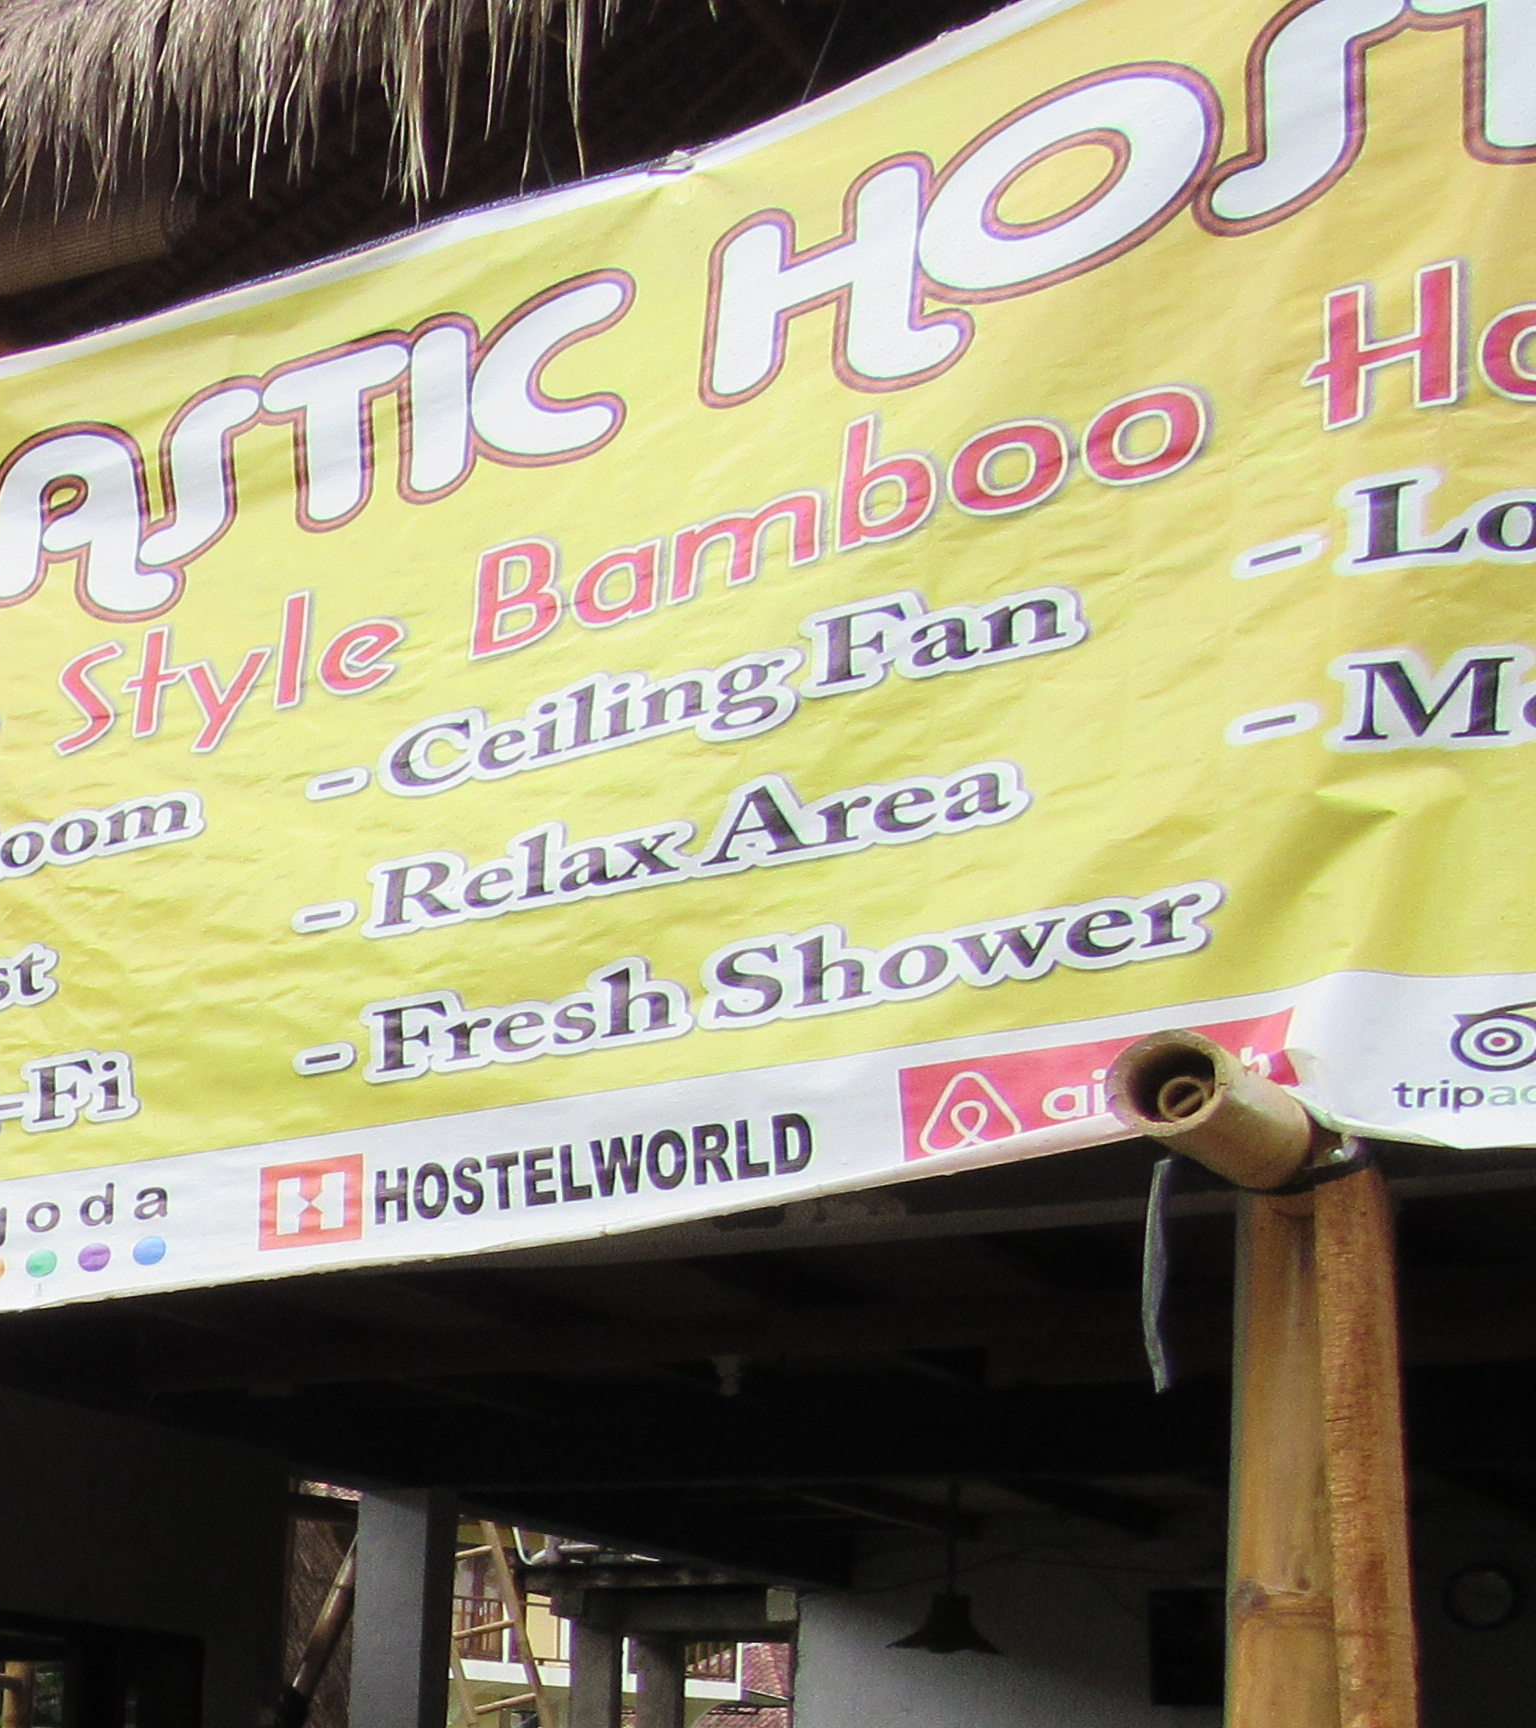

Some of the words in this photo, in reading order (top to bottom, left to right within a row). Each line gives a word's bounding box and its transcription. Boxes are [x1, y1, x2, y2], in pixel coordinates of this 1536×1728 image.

[56, 590, 406, 756] Style
[469, 384, 1212, 662] Bamboo
[388, 663, 778, 790] Ceiling
[813, 597, 1066, 688] Fan
[1343, 656, 1536, 742] M
[378, 829, 682, 932] Relax
[704, 770, 1009, 868] Area
[372, 965, 681, 1075] Fresh
[710, 888, 1205, 1021] Shower
[374, 1111, 813, 1226] HOSTELWORLD
